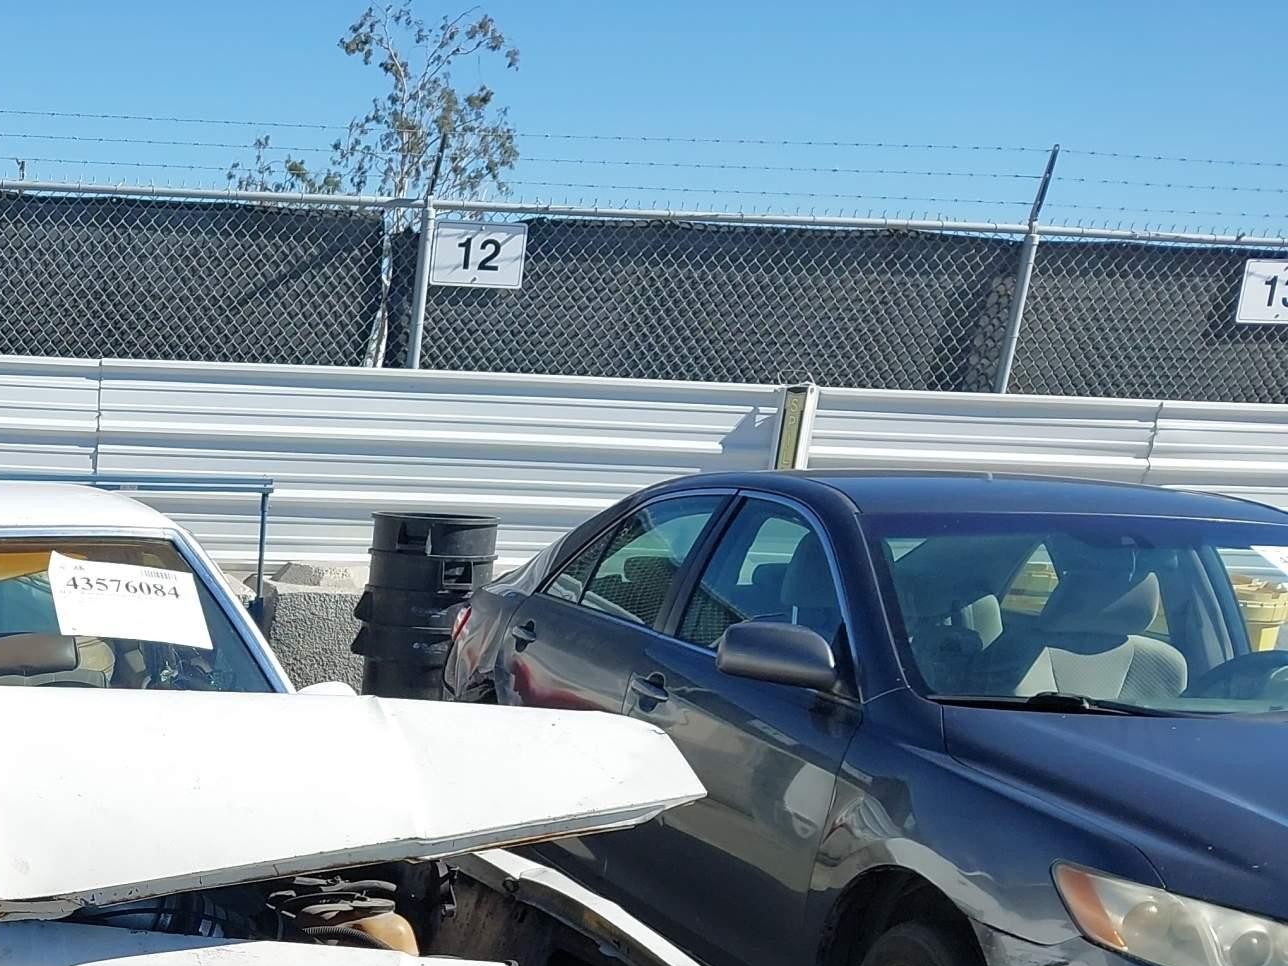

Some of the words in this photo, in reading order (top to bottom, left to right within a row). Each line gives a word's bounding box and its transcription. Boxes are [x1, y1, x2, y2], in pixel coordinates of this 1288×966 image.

[458, 237, 501, 271] 12
[1265, 275, 1288, 307] 1
[66, 576, 180, 599] 43576084
